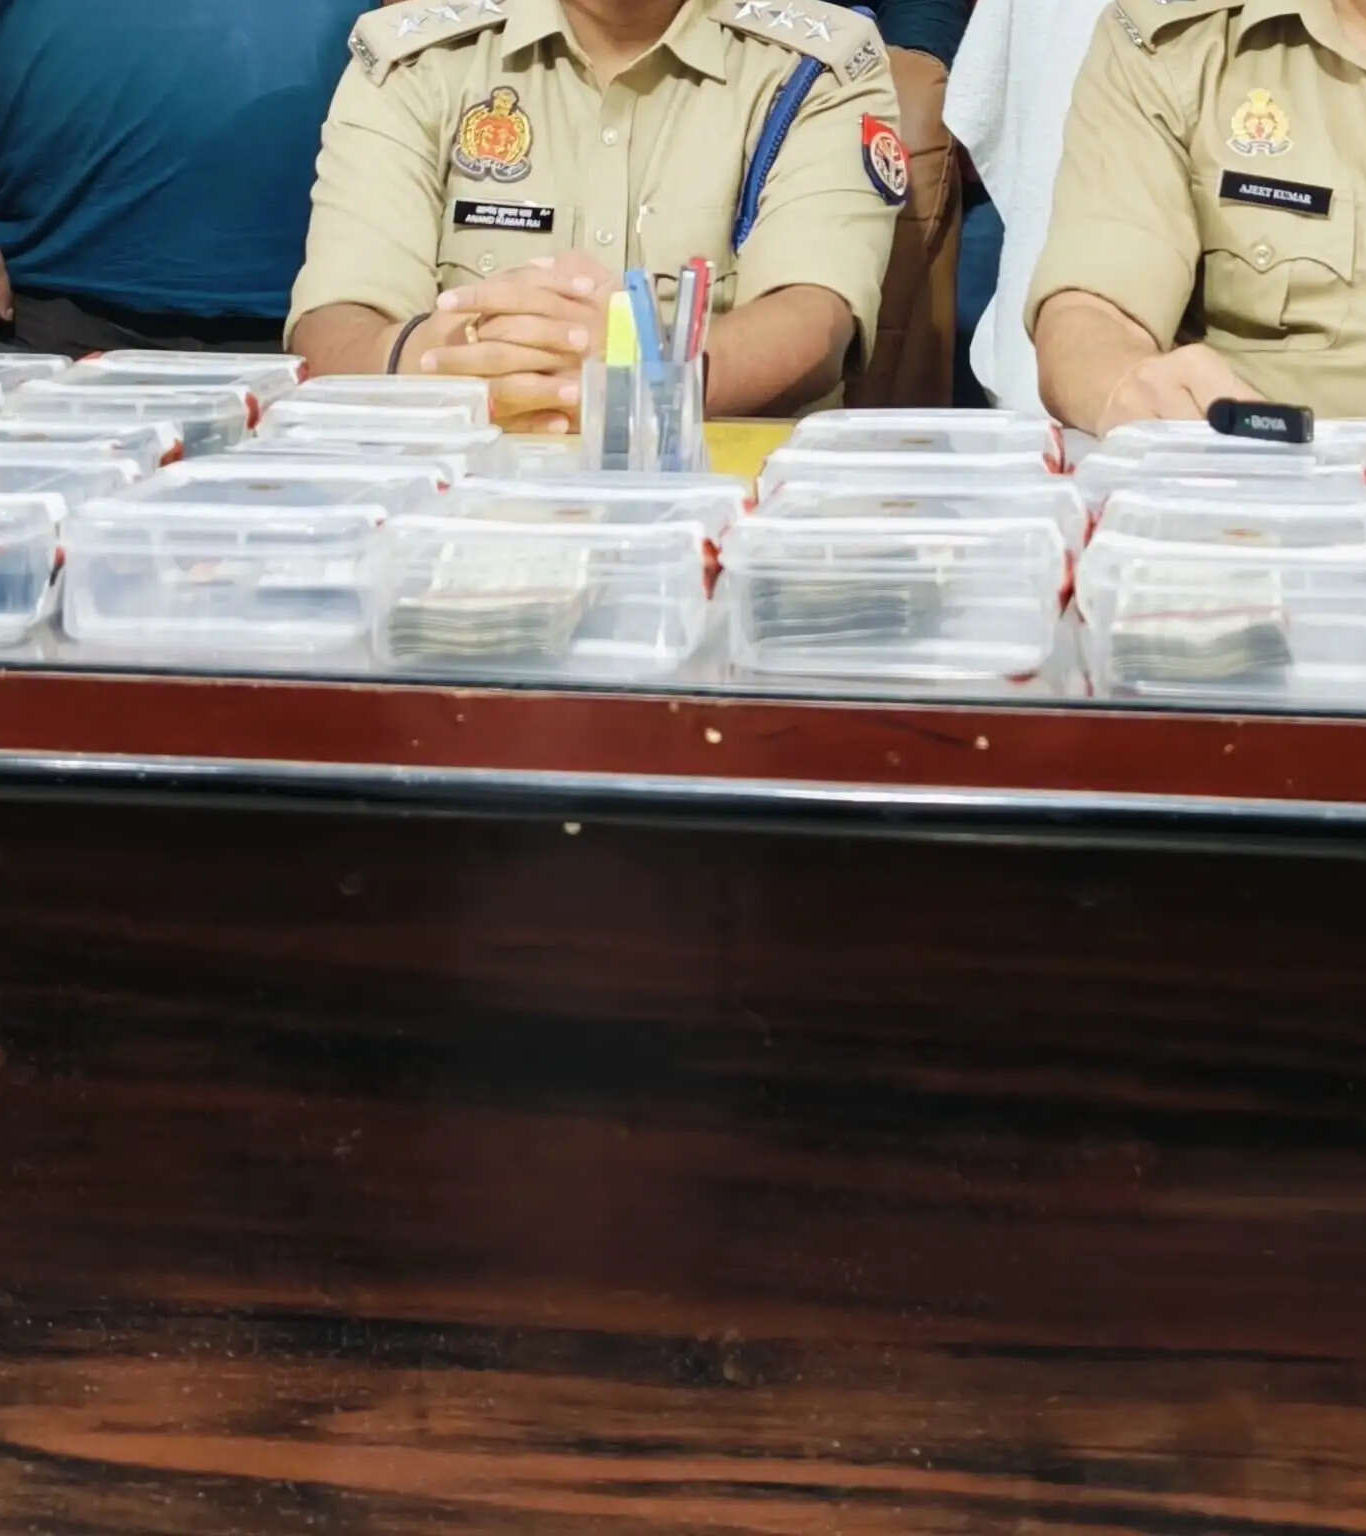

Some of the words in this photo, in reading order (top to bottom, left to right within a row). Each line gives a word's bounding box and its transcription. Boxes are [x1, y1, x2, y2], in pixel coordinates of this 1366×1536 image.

[1239, 183, 1273, 198] AJEET
[1273, 188, 1312, 204] KUMAR
[496, 216, 525, 227] KUMAR
[1251, 415, 1287, 431] BOYA
